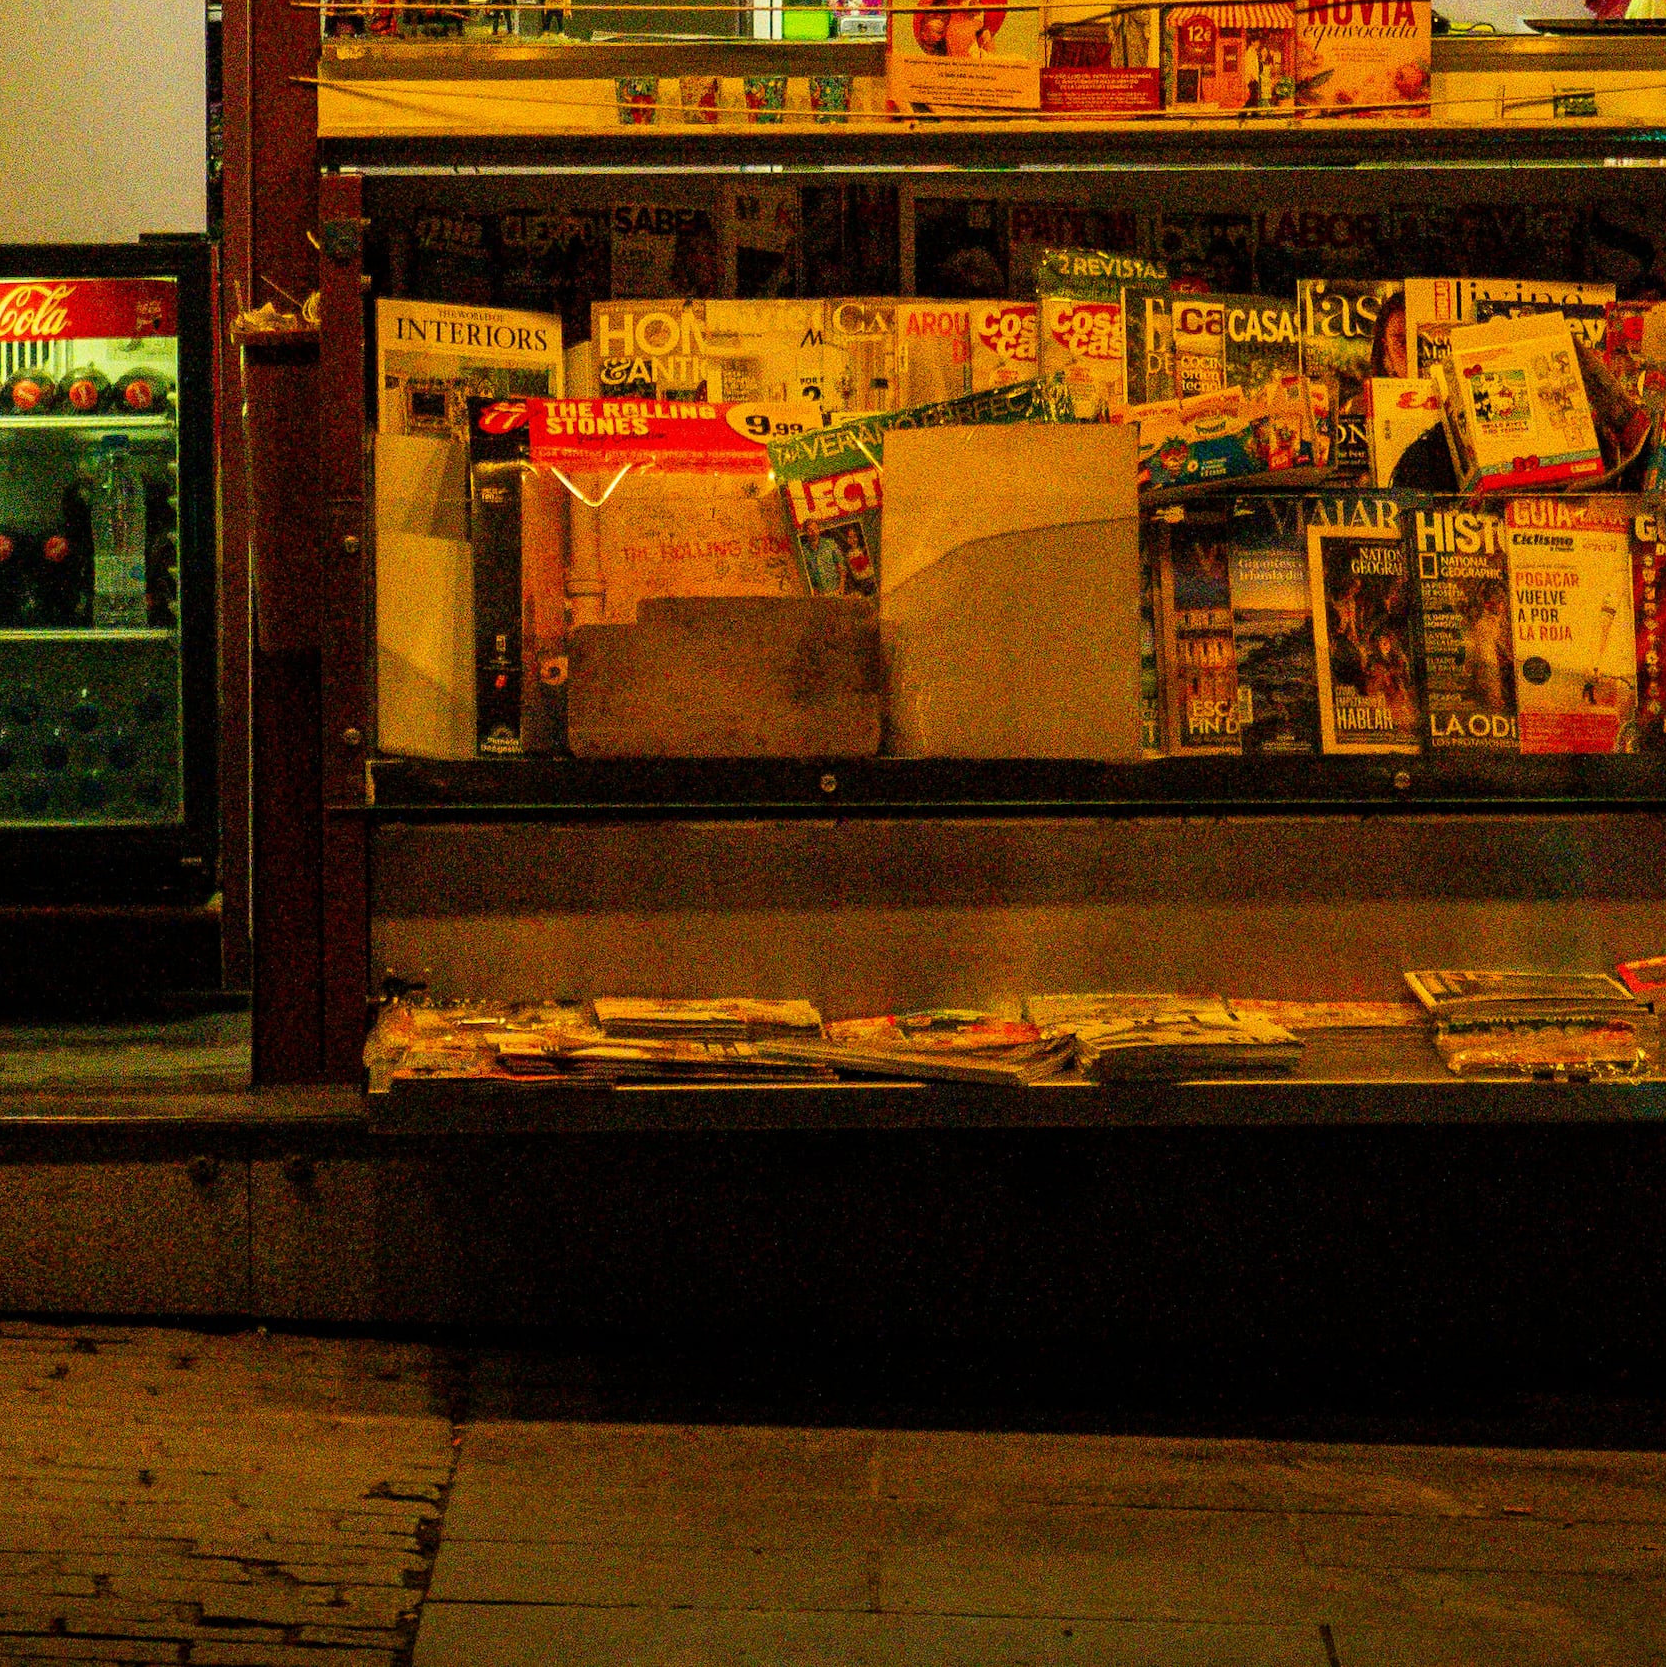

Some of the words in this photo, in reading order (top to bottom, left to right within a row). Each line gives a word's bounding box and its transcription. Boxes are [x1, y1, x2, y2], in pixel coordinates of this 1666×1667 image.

[1303, 21, 1418, 52] equivocada
[396, 317, 549, 353] INTERIORS
[545, 402, 592, 420] THE
[605, 404, 716, 421] ROLLING
[545, 419, 649, 436] STONES
[1513, 534, 1573, 548] Ciclismo
[1516, 590, 1568, 605] VUELVE
[1518, 608, 1529, 623] A
[1535, 608, 1560, 623] POR
[1519, 625, 1536, 641] LA
[1541, 625, 1573, 641] ROJA
[1430, 715, 1462, 738] LA
